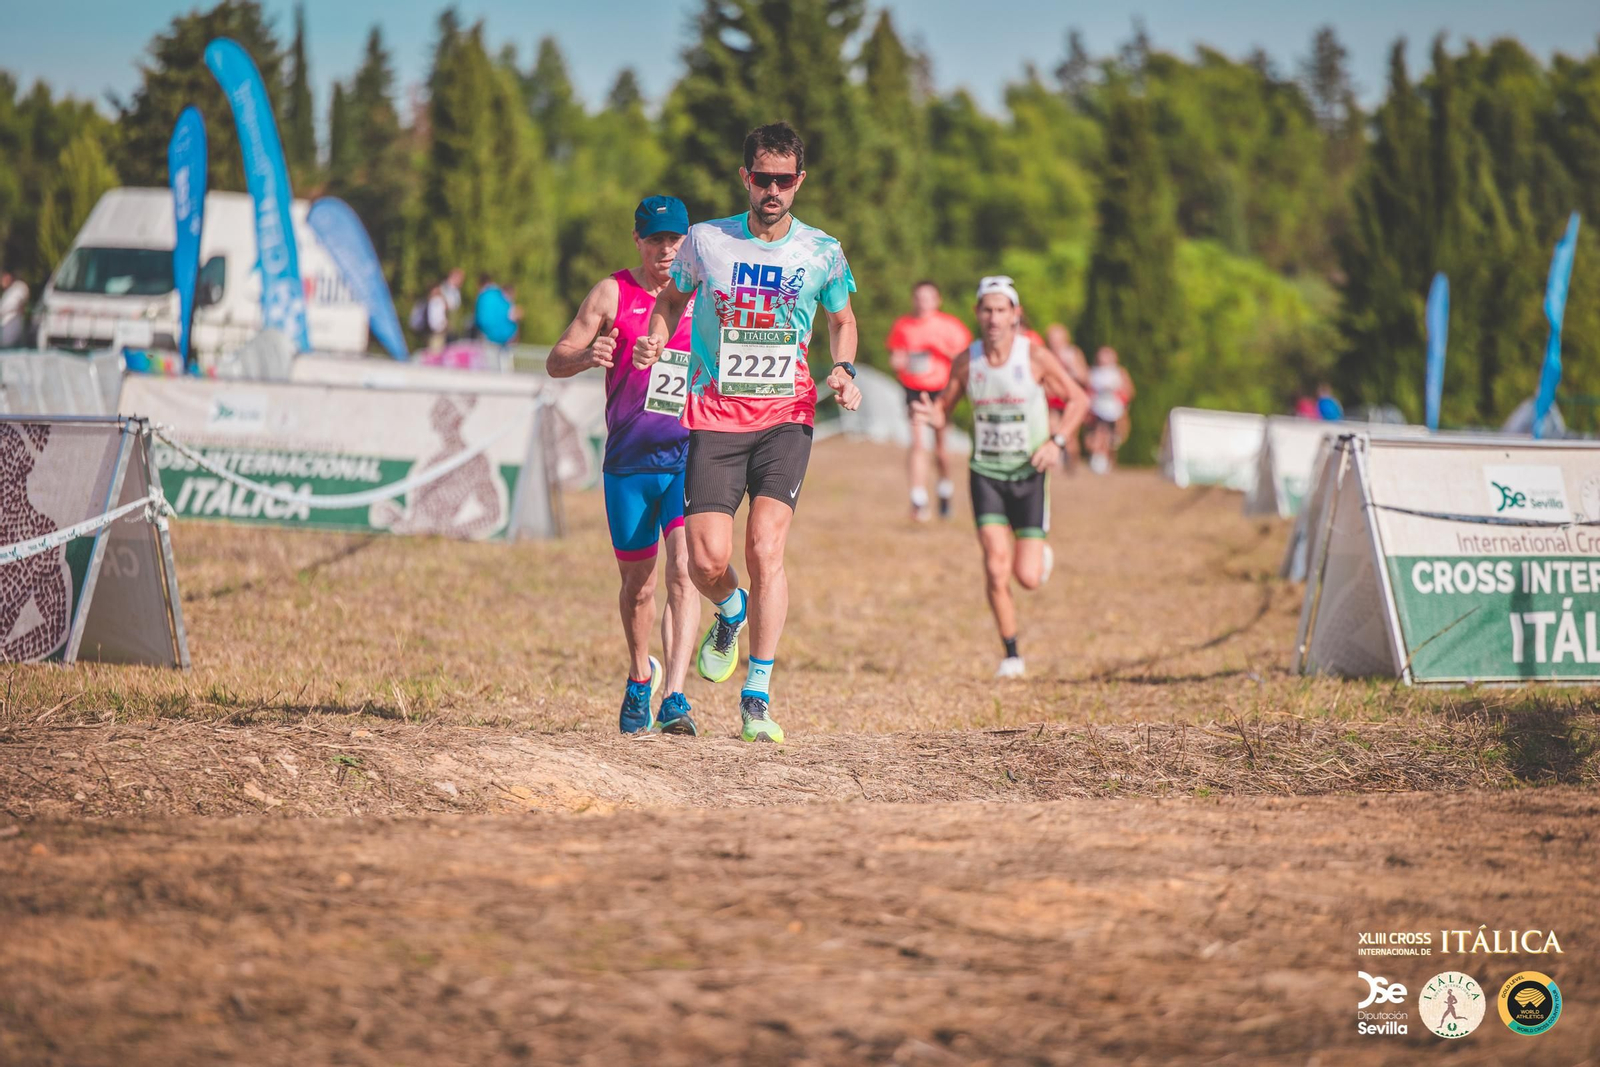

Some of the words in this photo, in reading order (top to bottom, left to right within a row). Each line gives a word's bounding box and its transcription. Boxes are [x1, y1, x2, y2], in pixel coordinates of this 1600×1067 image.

[744, 331, 780, 341] ITÁLICA
[728, 354, 792, 378] 2227
[655, 374, 686, 397] 22
[983, 431, 1025, 447] 2205
[1530, 497, 1563, 509] Sevilla
[1456, 531, 1573, 553] International
[1412, 561, 1516, 594] CROSS
[1522, 561, 1600, 594] INTER
[1510, 598, 1600, 663] ITÁL
